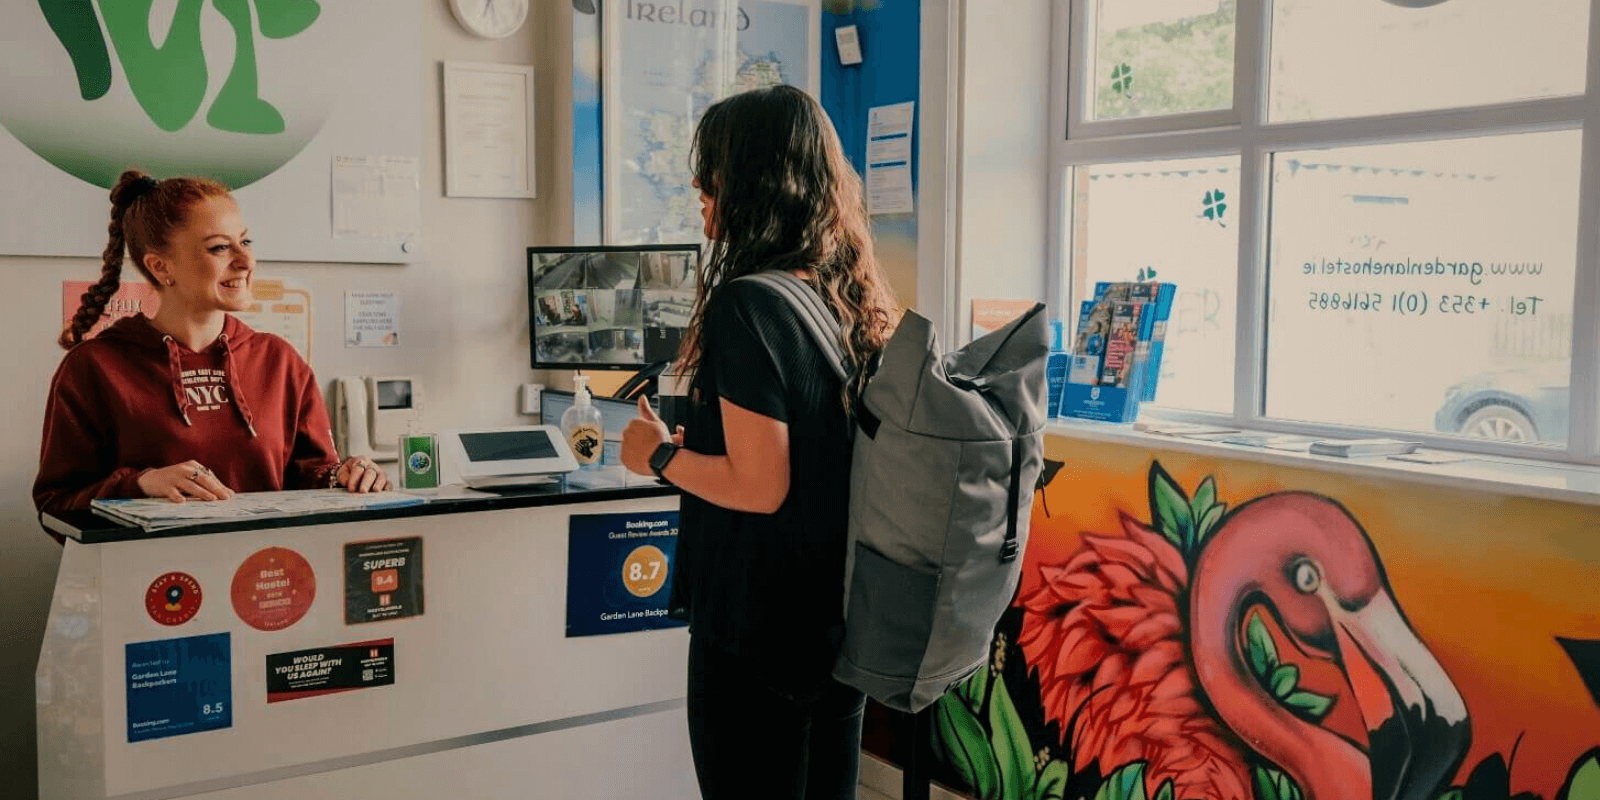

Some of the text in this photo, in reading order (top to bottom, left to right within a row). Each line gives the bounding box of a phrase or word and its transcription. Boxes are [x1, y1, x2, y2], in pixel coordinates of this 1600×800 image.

[185, 385, 229, 406] NYC
[625, 520, 669, 530] Booking.com
[363, 557, 406, 571] SUPERB
[629, 561, 661, 581] 8.7
[260, 567, 285, 579] Best
[256, 577, 290, 591] Hostel
[600, 608, 669, 621] Garden Lane Backpa
[293, 653, 325, 665] WOULD
[275, 658, 343, 675] YOU SLEEP WITH
[131, 669, 177, 680] Garden Lane
[287, 672, 300, 681] US
[299, 667, 332, 679] AGAIN?
[131, 678, 177, 689] Backpackers
[203, 701, 224, 716] 8.5
